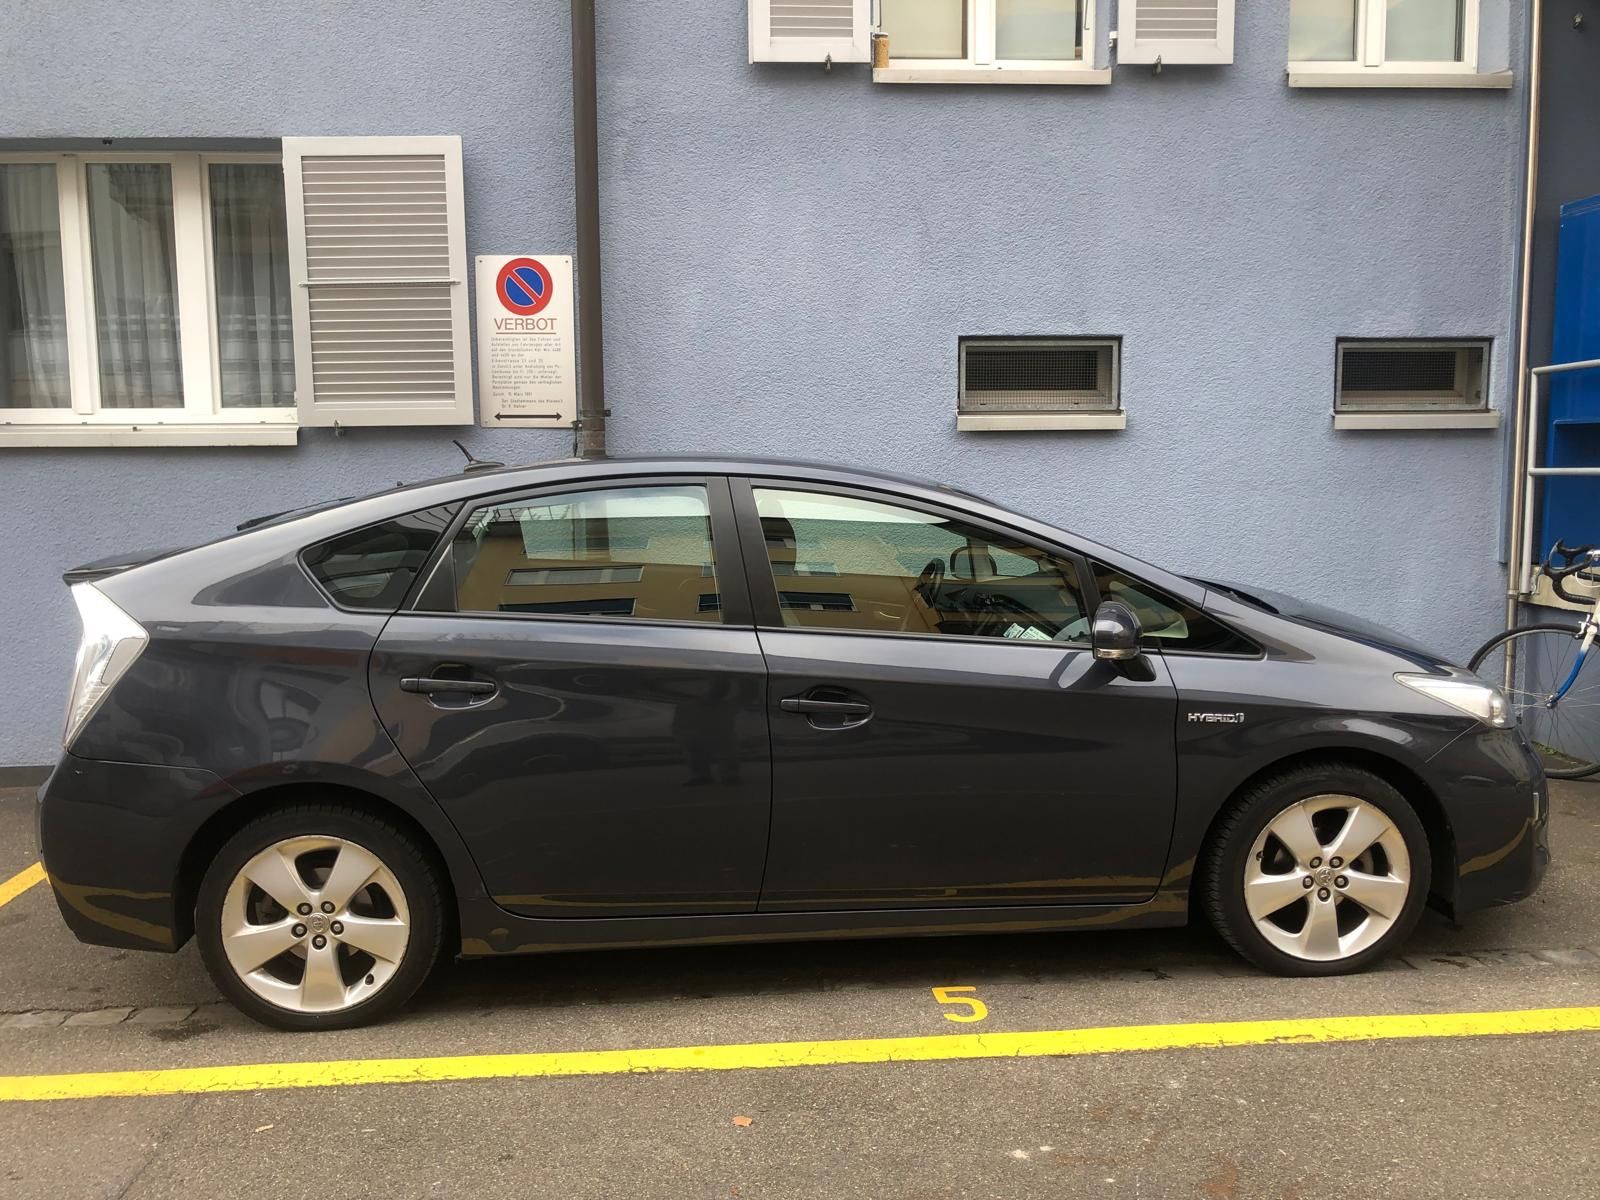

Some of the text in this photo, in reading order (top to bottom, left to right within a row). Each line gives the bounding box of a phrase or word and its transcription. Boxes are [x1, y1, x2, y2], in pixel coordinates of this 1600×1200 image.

[494, 318, 557, 331] VERBOT
[1187, 712, 1235, 723] HYBRID
[932, 986, 988, 1023] 5
